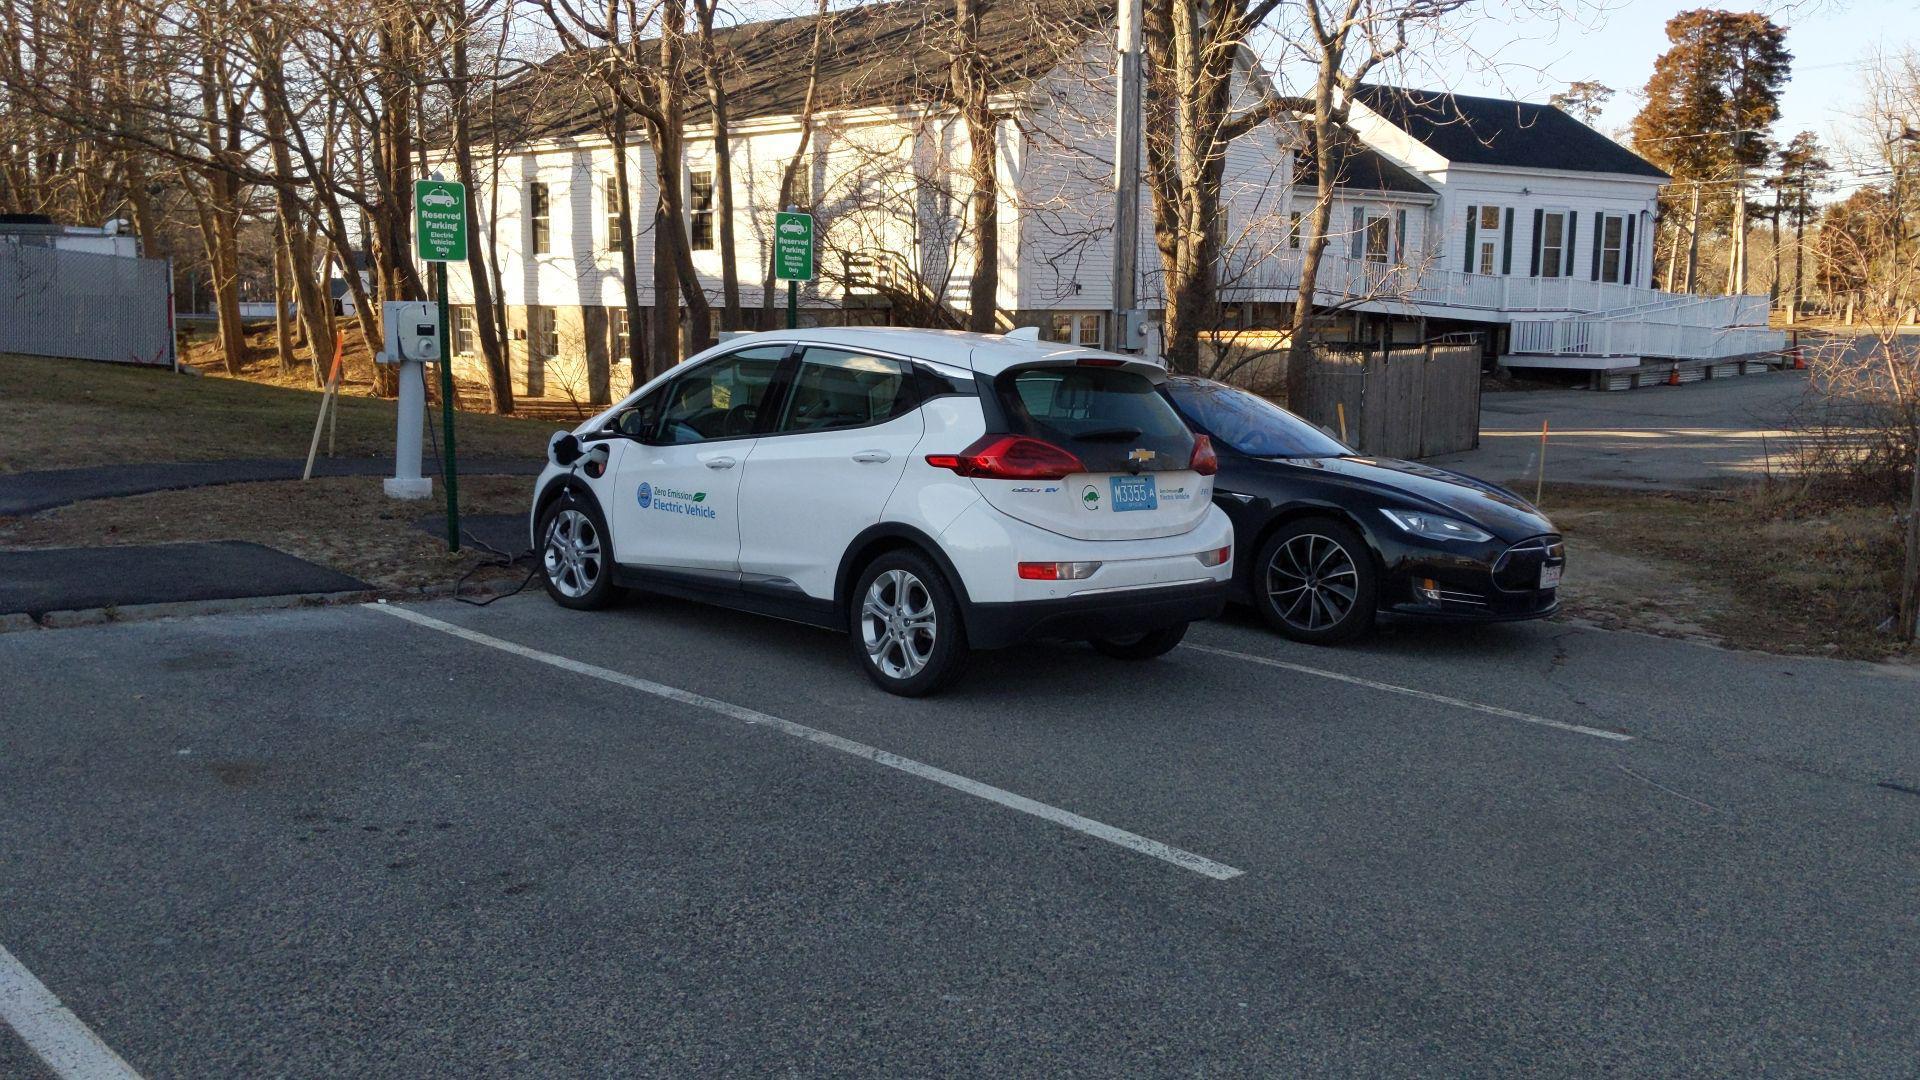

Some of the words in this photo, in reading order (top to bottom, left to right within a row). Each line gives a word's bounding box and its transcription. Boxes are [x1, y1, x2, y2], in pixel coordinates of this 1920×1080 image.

[422, 210, 461, 220] Reserved
[426, 220, 458, 232] Parking
[779, 237, 808, 246] Reserved
[782, 246, 806, 255] Parking
[654, 486, 667, 497] Zero
[668, 488, 693, 500] Emission
[1114, 484, 1147, 502] M3355
[1149, 488, 1155, 498] A
[654, 498, 684, 514] Electric
[684, 502, 716, 519] Vehicle
